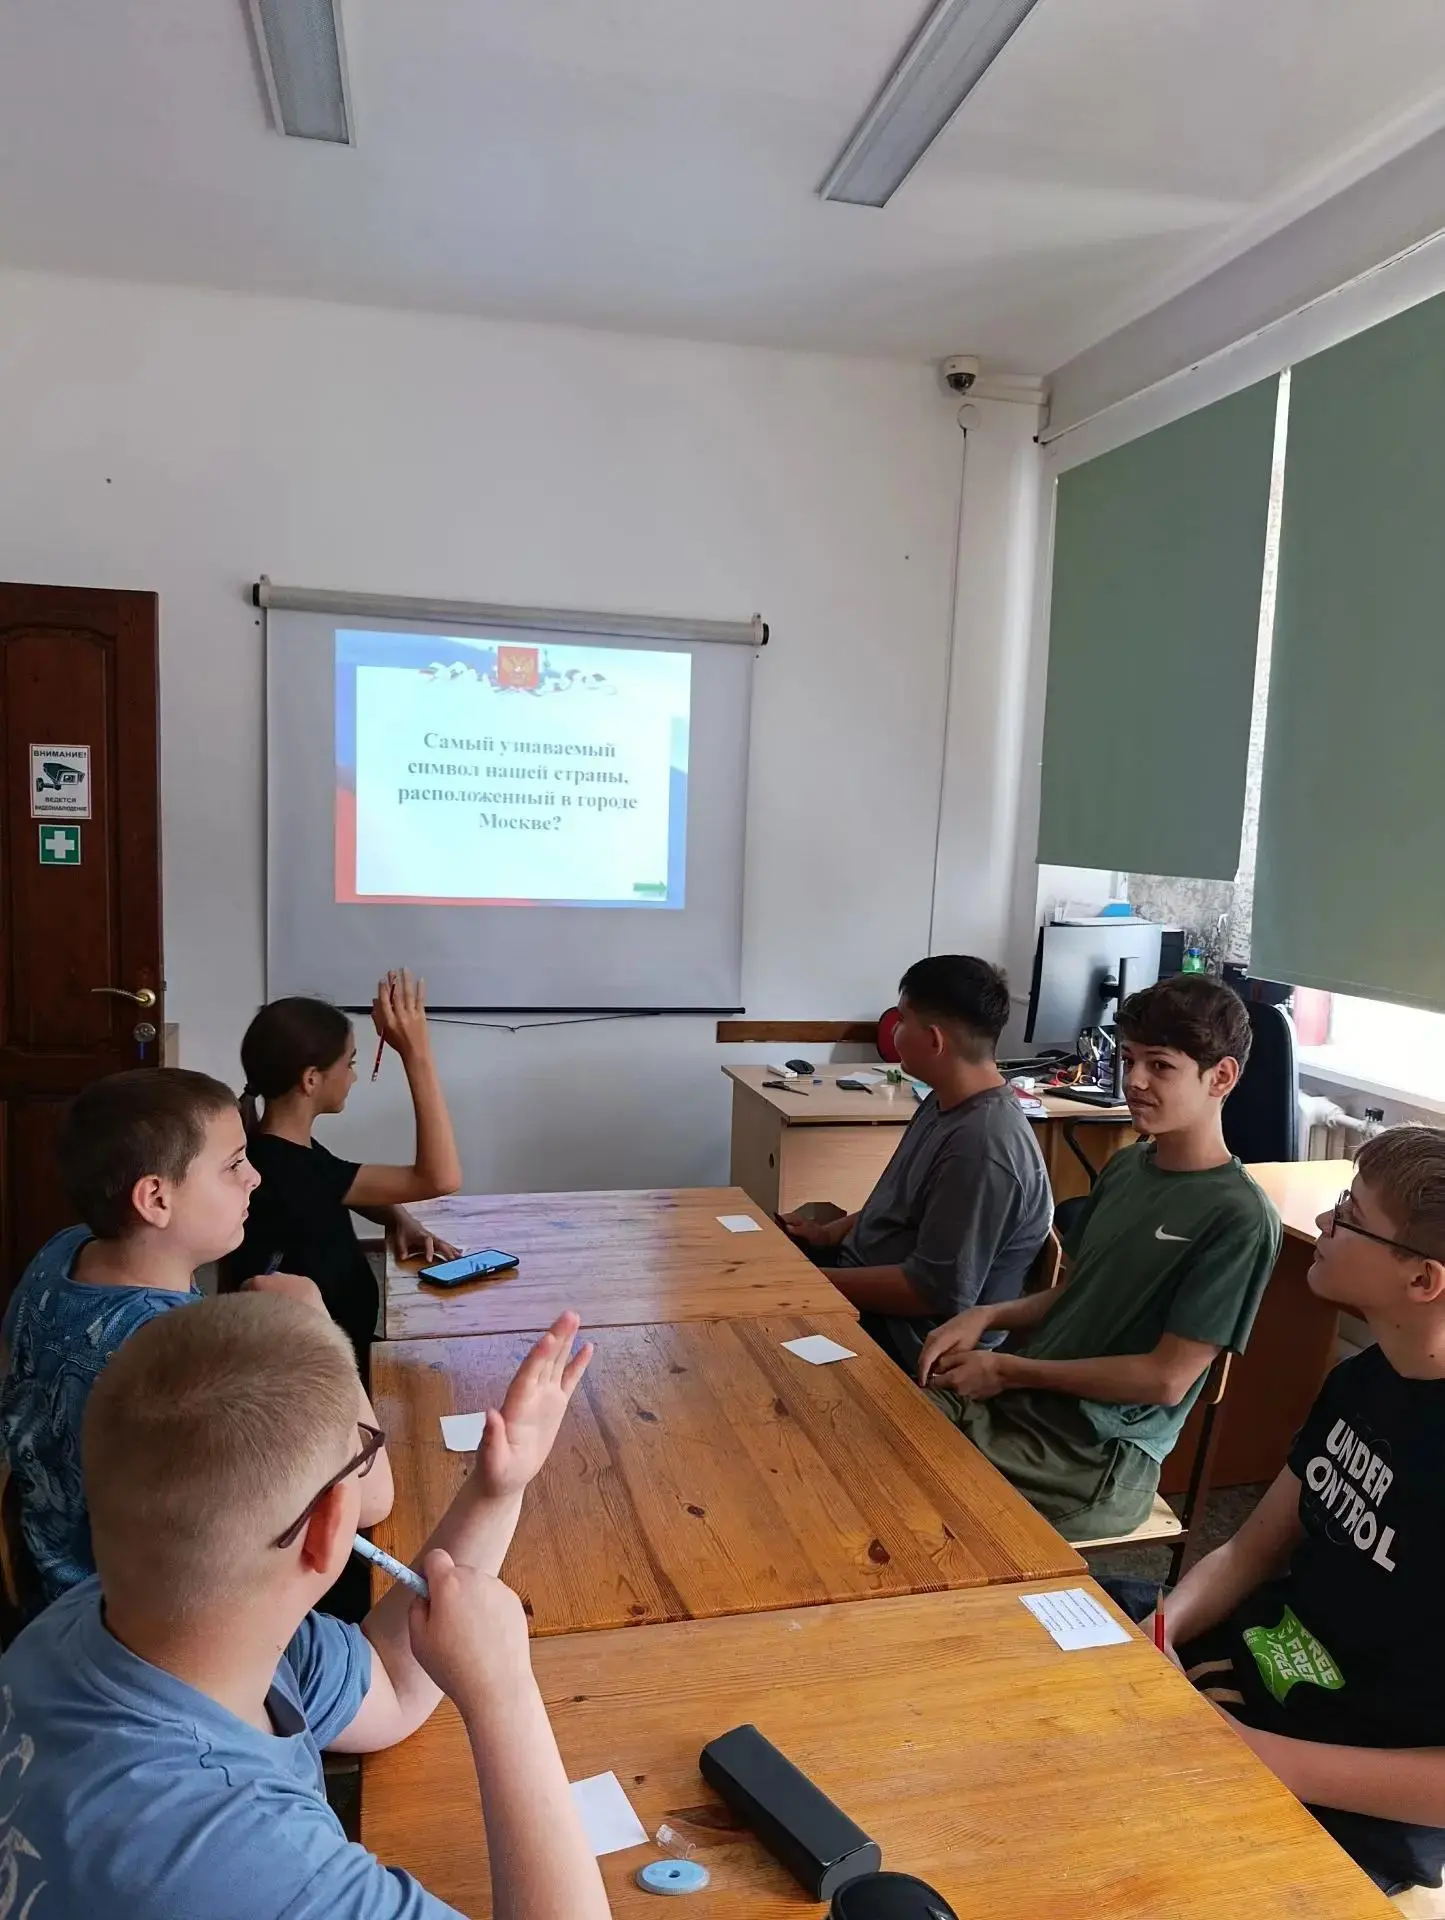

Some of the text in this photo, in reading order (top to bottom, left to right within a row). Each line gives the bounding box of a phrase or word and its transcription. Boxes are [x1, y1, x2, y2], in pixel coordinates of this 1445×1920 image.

[33, 750, 87, 758] ВНИМАНИЕ!
[424, 731, 616, 758] Самый узнаваемый
[407, 761, 479, 777] символ
[486, 764, 548, 780] нашей
[398, 786, 638, 812] расположенный в городе
[479, 813, 562, 831] Москве?
[1326, 1418, 1394, 1507] UNDER
[1266, 1640, 1300, 1681] FREE
